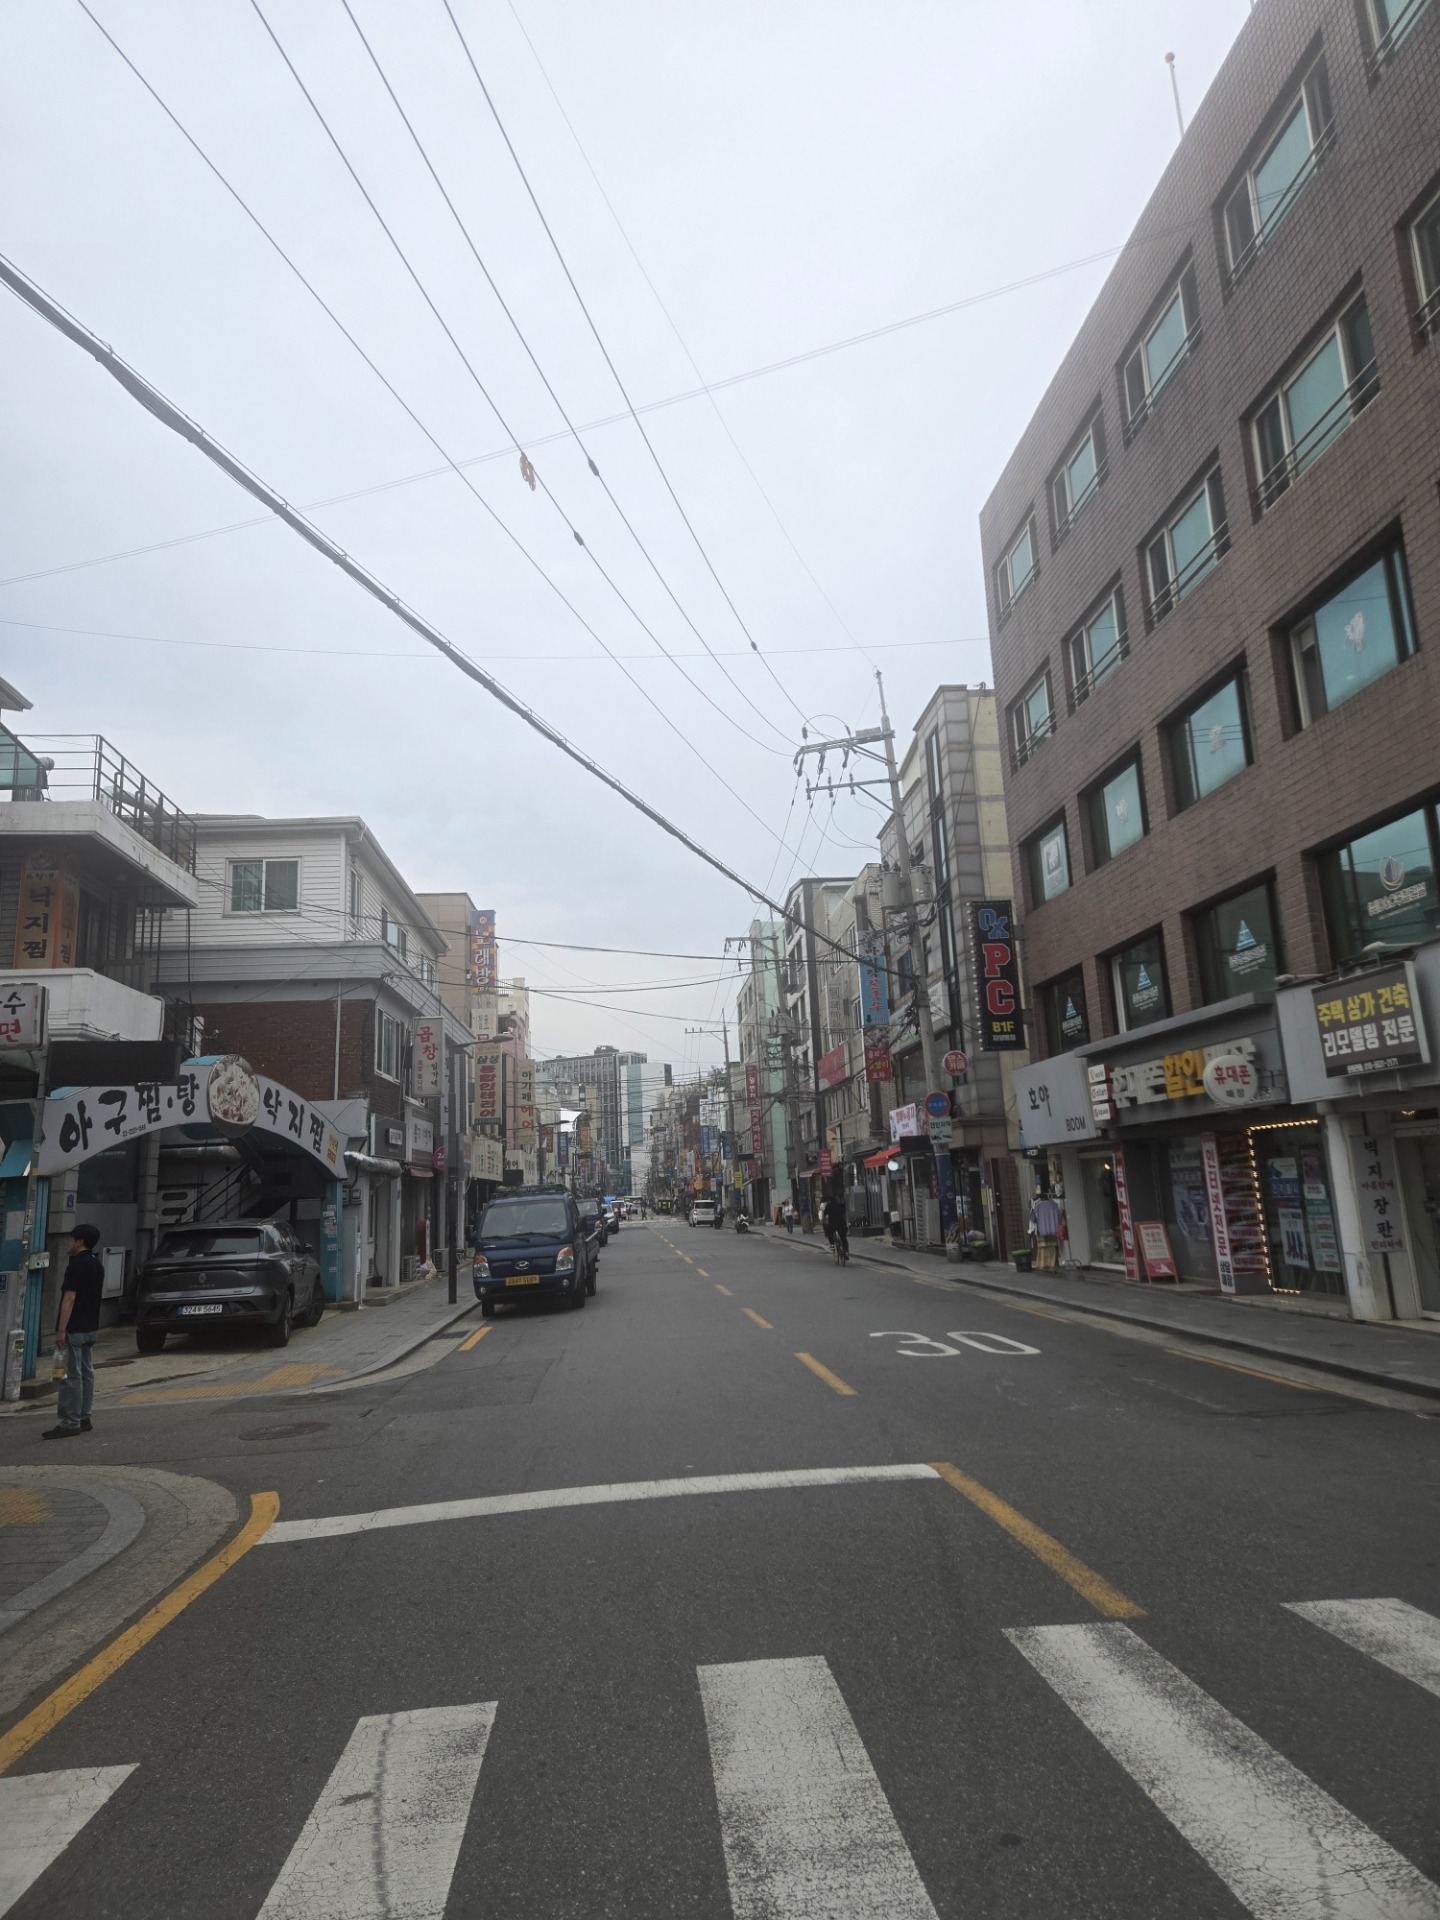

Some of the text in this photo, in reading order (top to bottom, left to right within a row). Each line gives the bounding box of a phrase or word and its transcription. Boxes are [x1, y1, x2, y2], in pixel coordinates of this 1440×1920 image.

[22, 885, 55, 959] 낙지찜
[982, 943, 1015, 1015] PC
[0, 991, 26, 1015] 수
[1317, 983, 1410, 1027] 주택 상가 건축
[992, 1021, 1015, 1033] B1F
[1322, 1014, 1416, 1057] 리모델링 전문
[416, 1026, 439, 1061] 곱창
[477, 1055, 499, 1065] 삼성
[430, 1062, 439, 1088] 김가네
[1214, 1065, 1252, 1086] 휴대폰
[1226, 1088, 1245, 1099] 매장
[520, 1104, 535, 1132] 헤어
[1065, 1116, 1087, 1132] BOOM
[1363, 1138, 1383, 1180] 벽지
[1361, 1179, 1395, 1190] 아름답게
[1373, 1196, 1394, 1239] 장판
[1371, 1239, 1403, 1249] 편리하게
[869, 1331, 1041, 1356] 30
